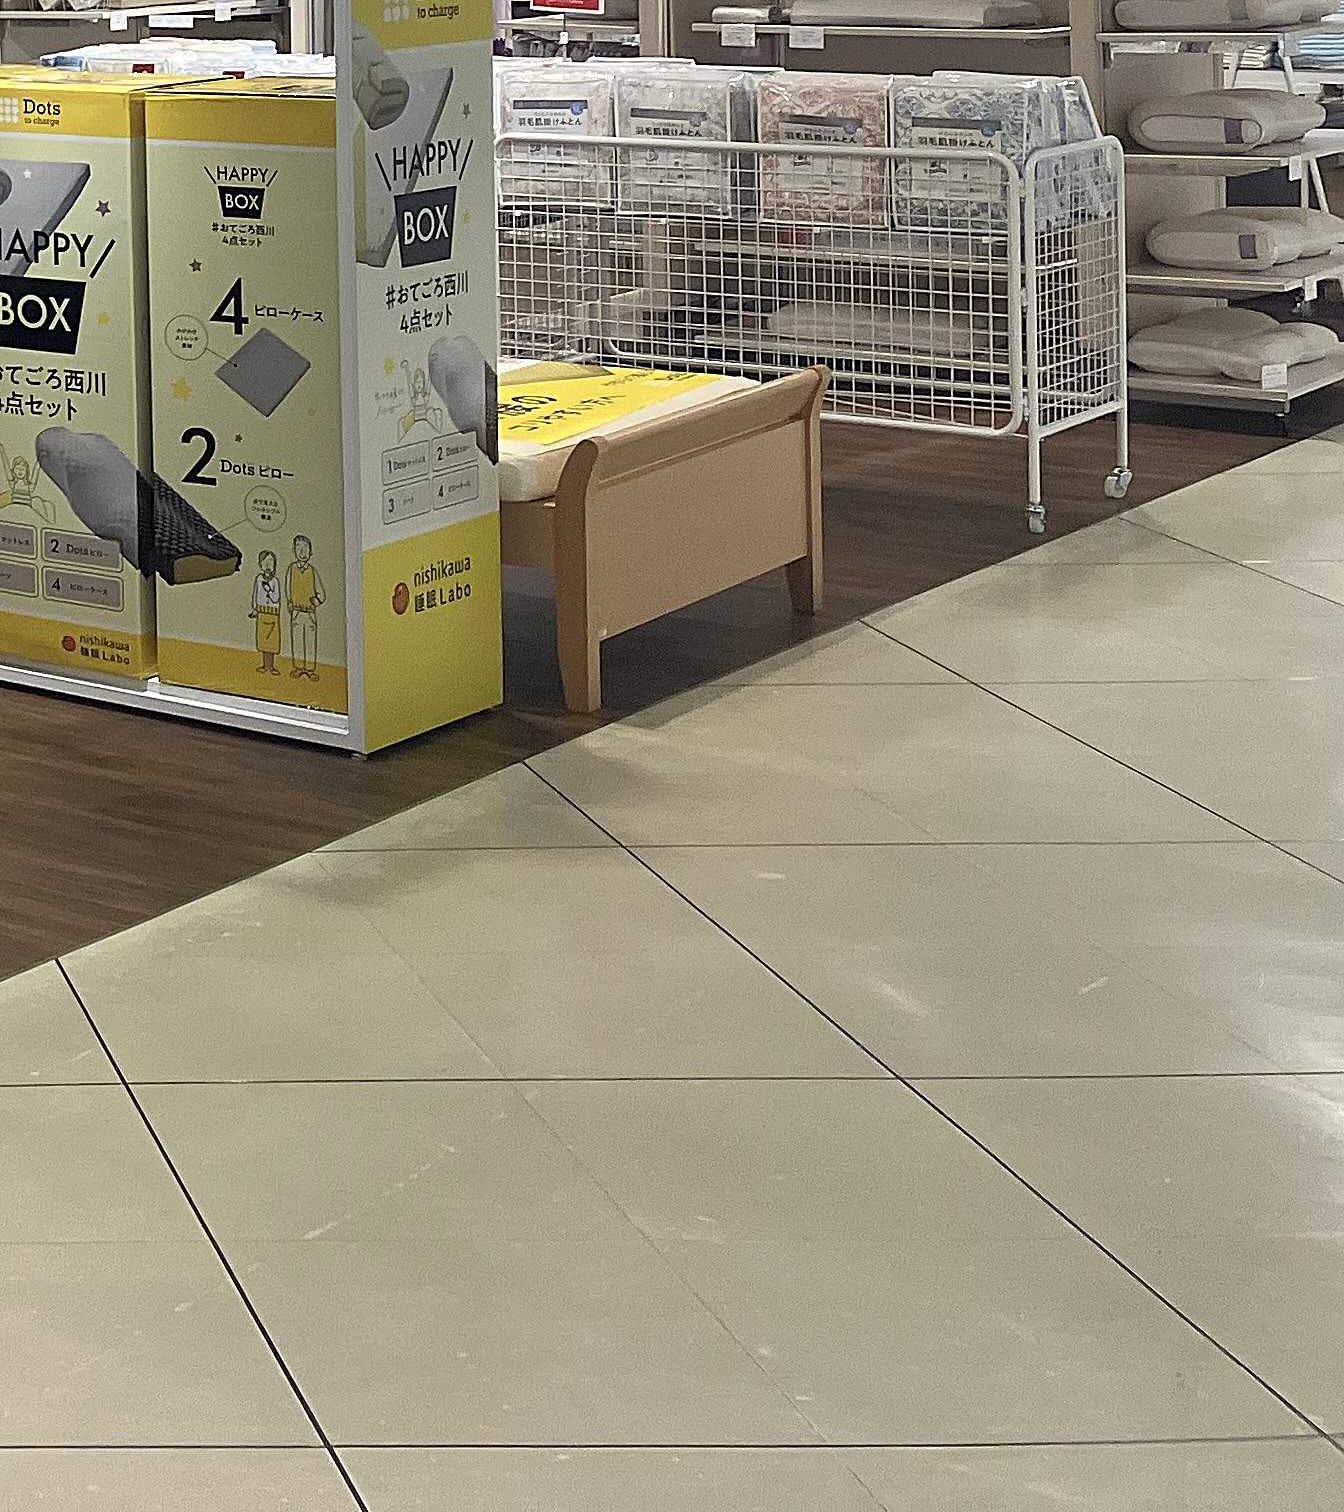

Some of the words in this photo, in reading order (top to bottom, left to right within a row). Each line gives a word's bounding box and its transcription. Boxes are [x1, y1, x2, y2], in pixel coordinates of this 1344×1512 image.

[417, 7, 426, 18] to
[428, 4, 460, 20] charge
[23, 98, 61, 117] Dots
[393, 138, 462, 181] HAPPY
[216, 165, 268, 184] HAPPY
[225, 194, 260, 210] BOX
[211, 222, 275, 237] #おてごろ西川
[403, 204, 449, 245] BOX
[222, 235, 262, 247] 4点セット
[385, 271, 469, 310] #おてごろ西川
[209, 277, 249, 335] 4
[254, 304, 324, 323] ピローケース
[400, 305, 453, 334] 4点セット
[181, 427, 217, 486] 2
[221, 460, 255, 476] Dots
[258, 464, 294, 479] ピロー
[50, 539, 60, 553] 2
[414, 556, 471, 587] nishikawa
[51, 578, 61, 591] 4
[79, 635, 130, 653] nishikawa
